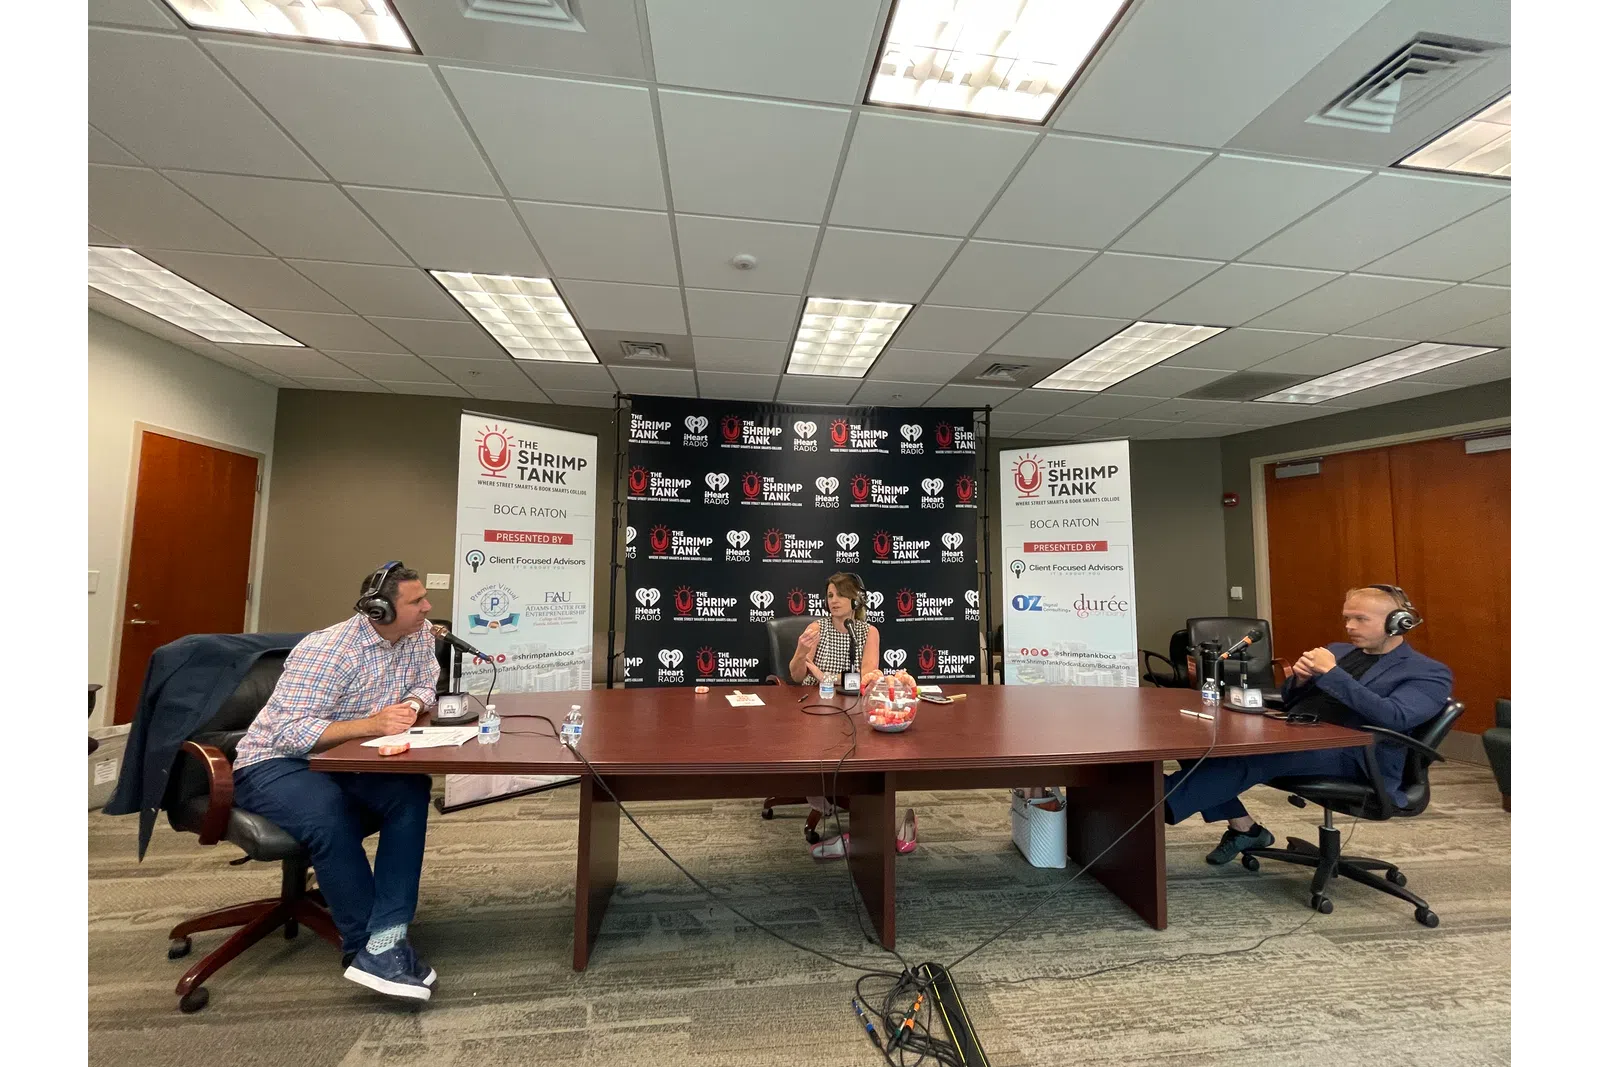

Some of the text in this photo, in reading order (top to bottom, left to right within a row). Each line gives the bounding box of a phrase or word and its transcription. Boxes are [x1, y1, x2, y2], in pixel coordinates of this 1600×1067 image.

[631, 420, 672, 431] SHRIMP
[631, 429, 658, 440] TANK
[743, 426, 782, 436] SHRIMP
[851, 430, 889, 440] SHRIMP
[684, 433, 708, 441] iHeart
[743, 436, 770, 445] TANK
[518, 440, 539, 450] THE
[683, 440, 708, 448] RADIO
[851, 439, 878, 448] TANK
[518, 450, 588, 471] SHRIMP
[1048, 460, 1066, 468] THE
[517, 466, 567, 485] TANK
[1048, 465, 1119, 482] SHRIMP
[650, 478, 692, 489] SHRIMP
[763, 483, 803, 492] SHRIMP
[650, 487, 679, 497] TANK
[872, 485, 910, 495] SHRIMP
[1048, 482, 1097, 497] TANK
[704, 491, 729, 499] iHeart
[763, 492, 790, 501] TANK
[872, 494, 898, 504] TANK
[494, 505, 567, 519] BOCA RATON
[1030, 518, 1100, 529] BOCA RATON
[497, 533, 564, 544] PRESENTED BY
[672, 537, 713, 547] SHRIMP
[785, 540, 824, 549] SHRIMP
[893, 541, 931, 550] SHRIMP
[1034, 543, 1097, 552] PRESENTED BY
[672, 546, 701, 556] TANK
[784, 549, 812, 558] TANK
[893, 550, 920, 560] TANK
[490, 556, 514, 564] Client
[516, 557, 552, 565] Focused
[470, 583, 519, 601] Premier Virtual
[545, 592, 572, 603] FAU
[491, 597, 500, 611] P
[696, 598, 738, 608] SHRIMP
[916, 598, 953, 608] SHRIMP
[1074, 594, 1128, 612] durée
[696, 607, 725, 617] TANK
[750, 609, 775, 617] iHeart
[916, 607, 943, 616] TANK
[512, 650, 574, 661] @shrimptankboca
[938, 655, 975, 664] SHRIMP
[1054, 650, 1116, 660] @shrimptankboca
[624, 657, 643, 667] IMP
[718, 658, 759, 668] SHRIMP
[658, 669, 684, 677] iHeart
[718, 668, 747, 677] TANK
[938, 665, 964, 674] TANK
